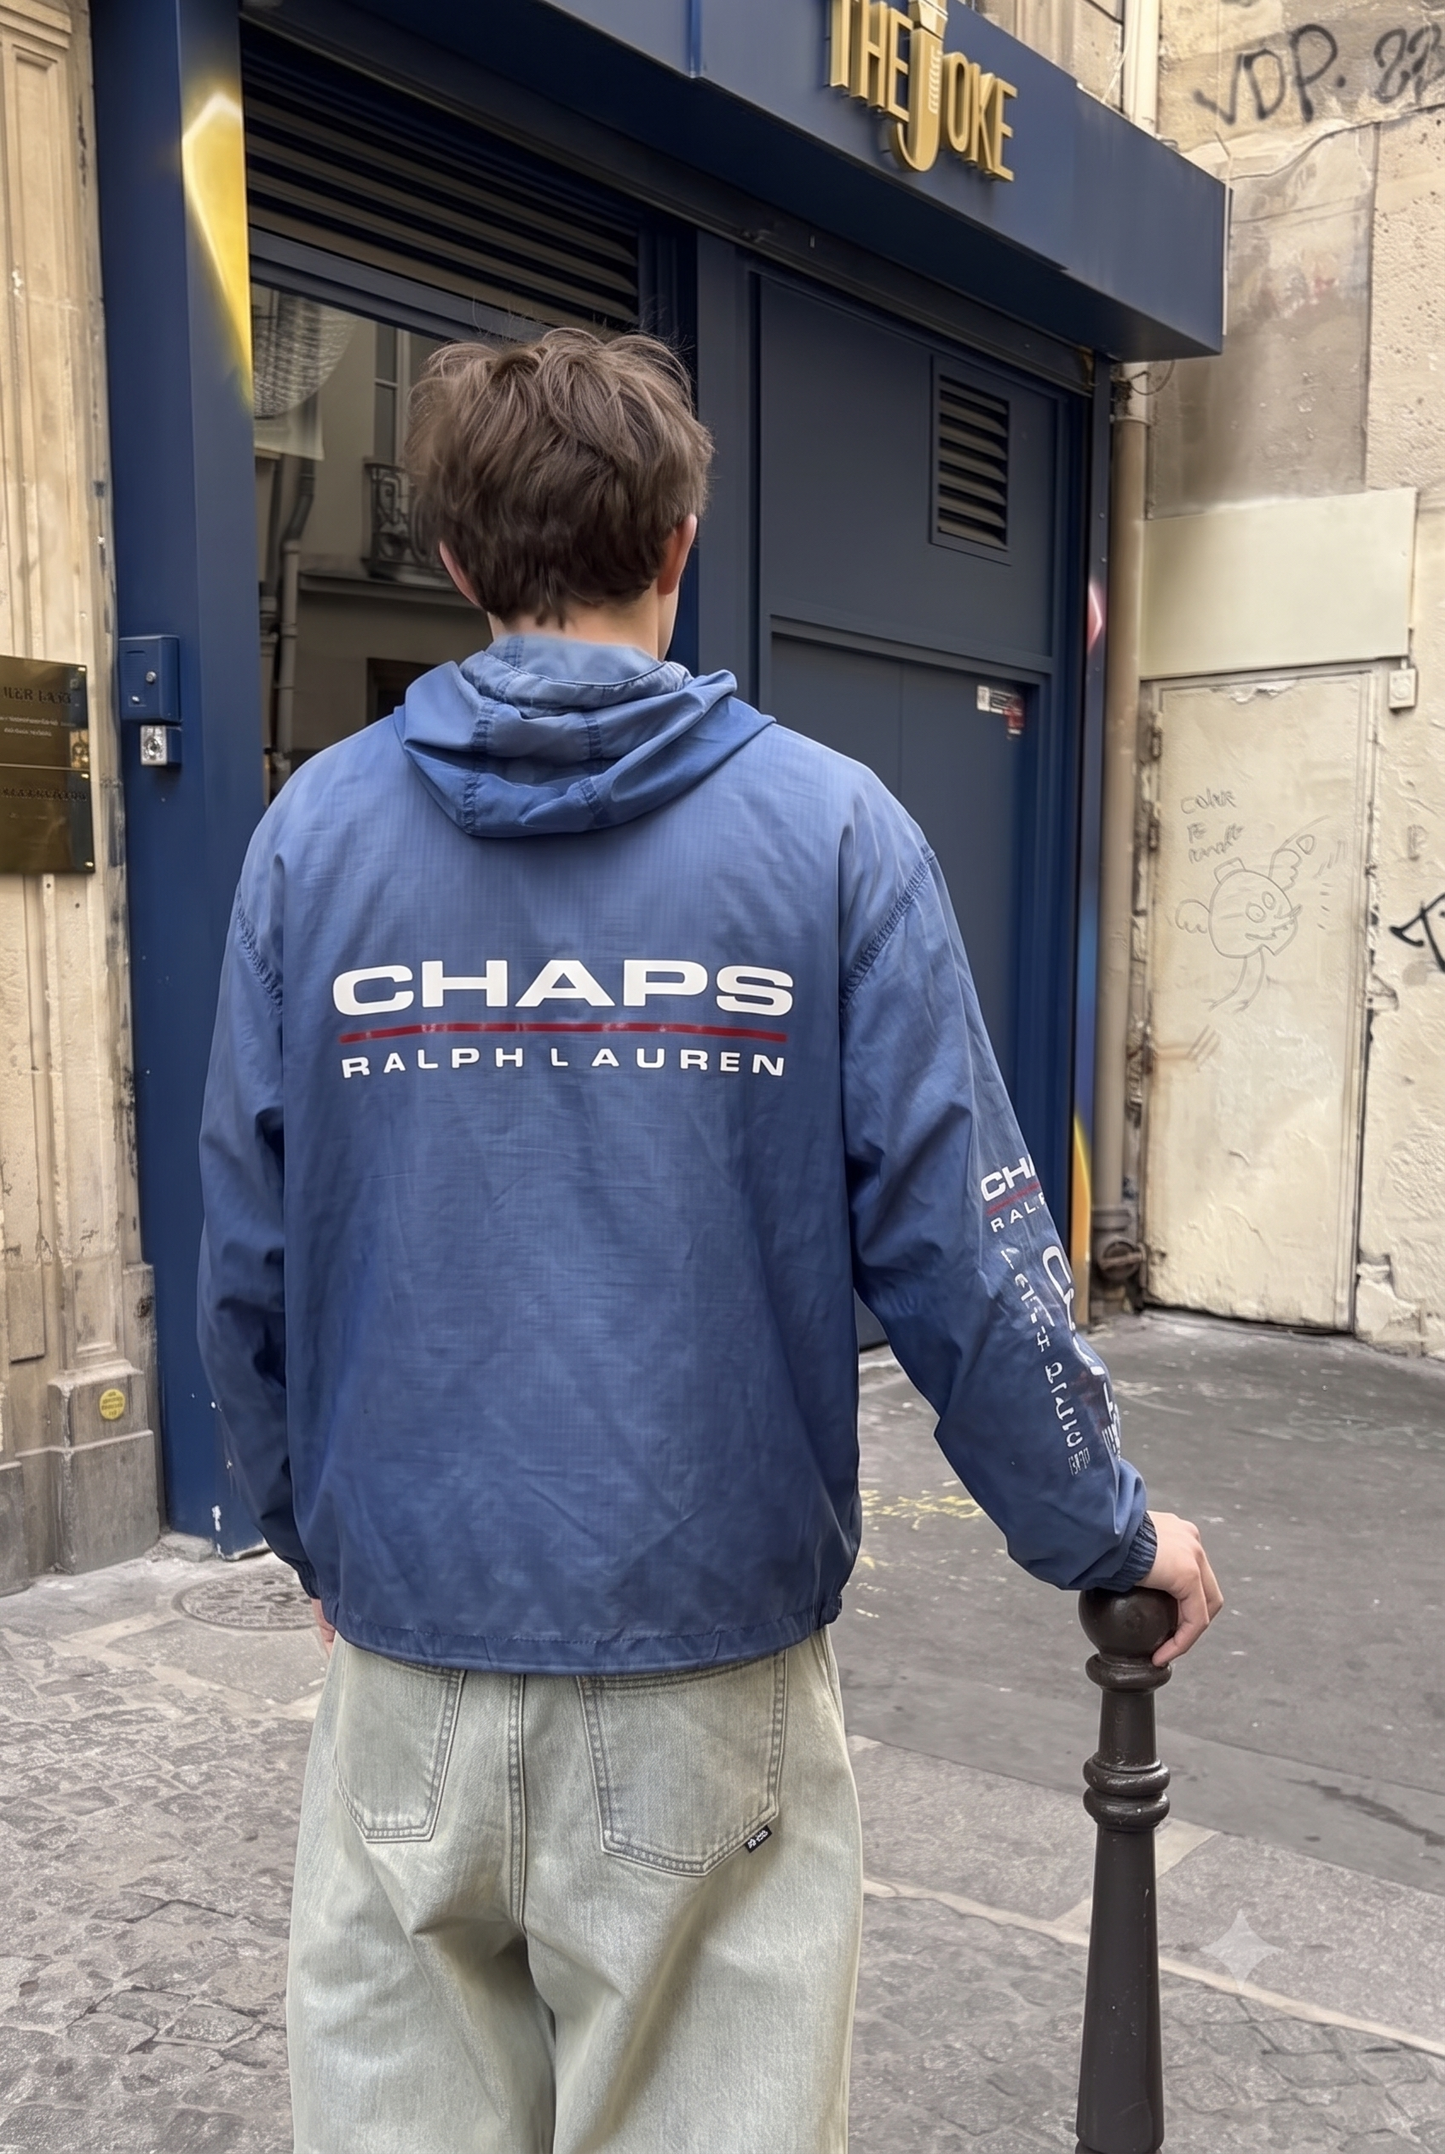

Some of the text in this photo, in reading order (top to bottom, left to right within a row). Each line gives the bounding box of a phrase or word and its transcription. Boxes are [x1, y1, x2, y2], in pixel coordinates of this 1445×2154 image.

[830, 0, 1018, 182] THE JOKE
[333, 960, 793, 1015] CHAPS
[342, 1048, 783, 1078] RALPH LAUREN
